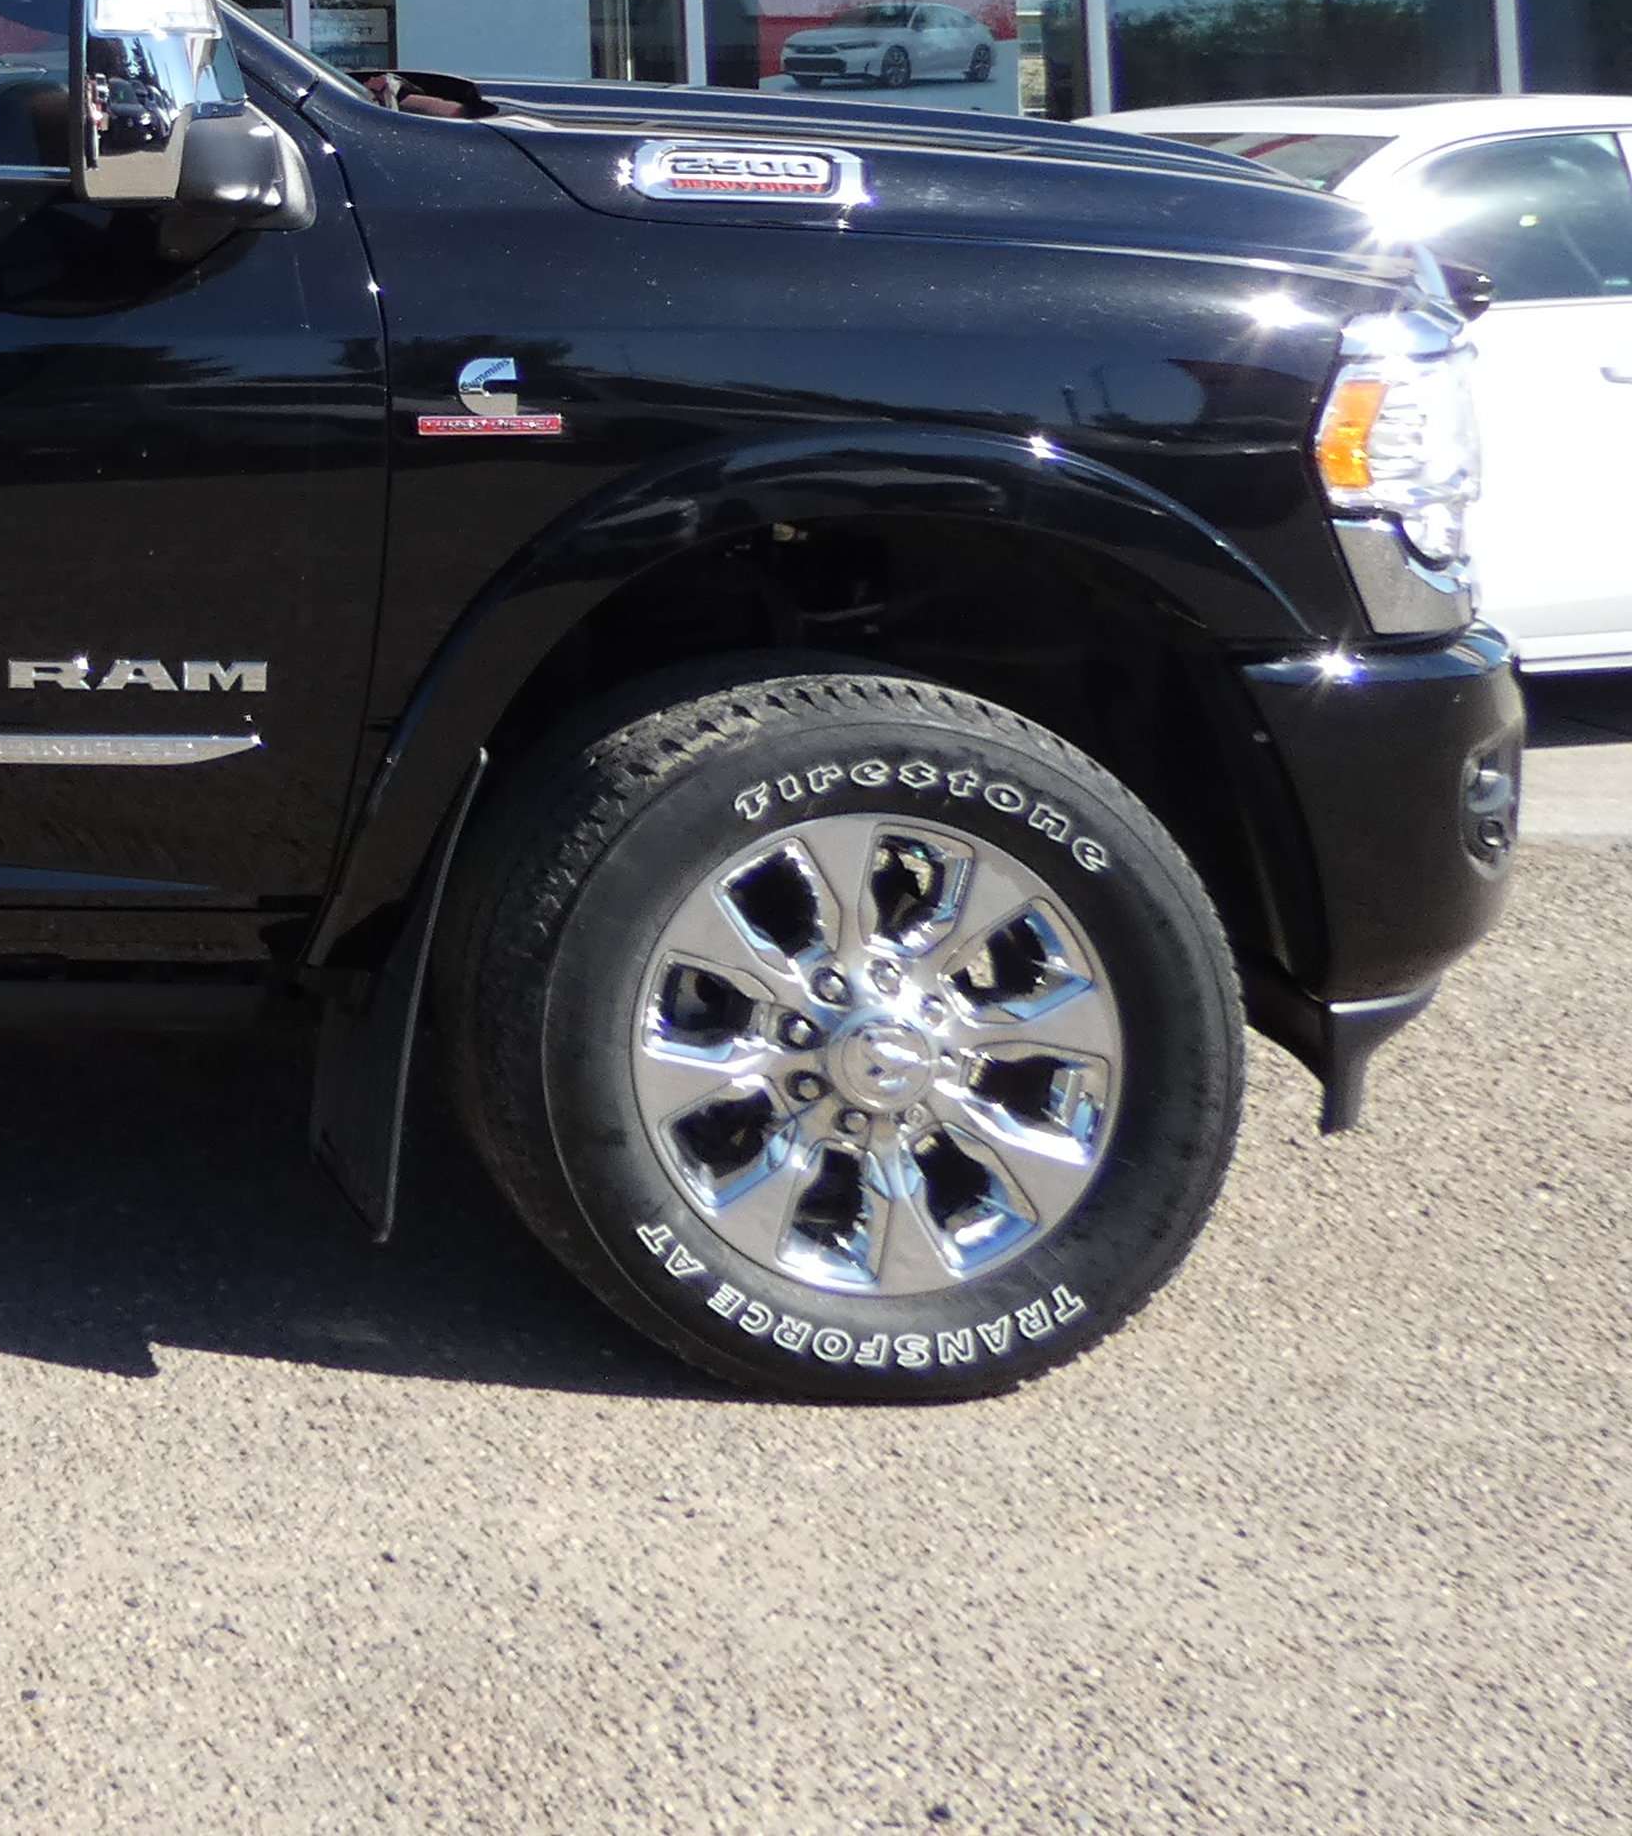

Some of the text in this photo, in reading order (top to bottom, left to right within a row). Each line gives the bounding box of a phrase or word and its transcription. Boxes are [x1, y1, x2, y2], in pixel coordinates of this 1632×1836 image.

[668, 156, 818, 178] 2500
[460, 358, 510, 392] Cummins
[8, 659, 268, 692] RAM
[733, 759, 1111, 874] Firestone
[635, 1220, 1087, 1369] TRANSFORCE AT
